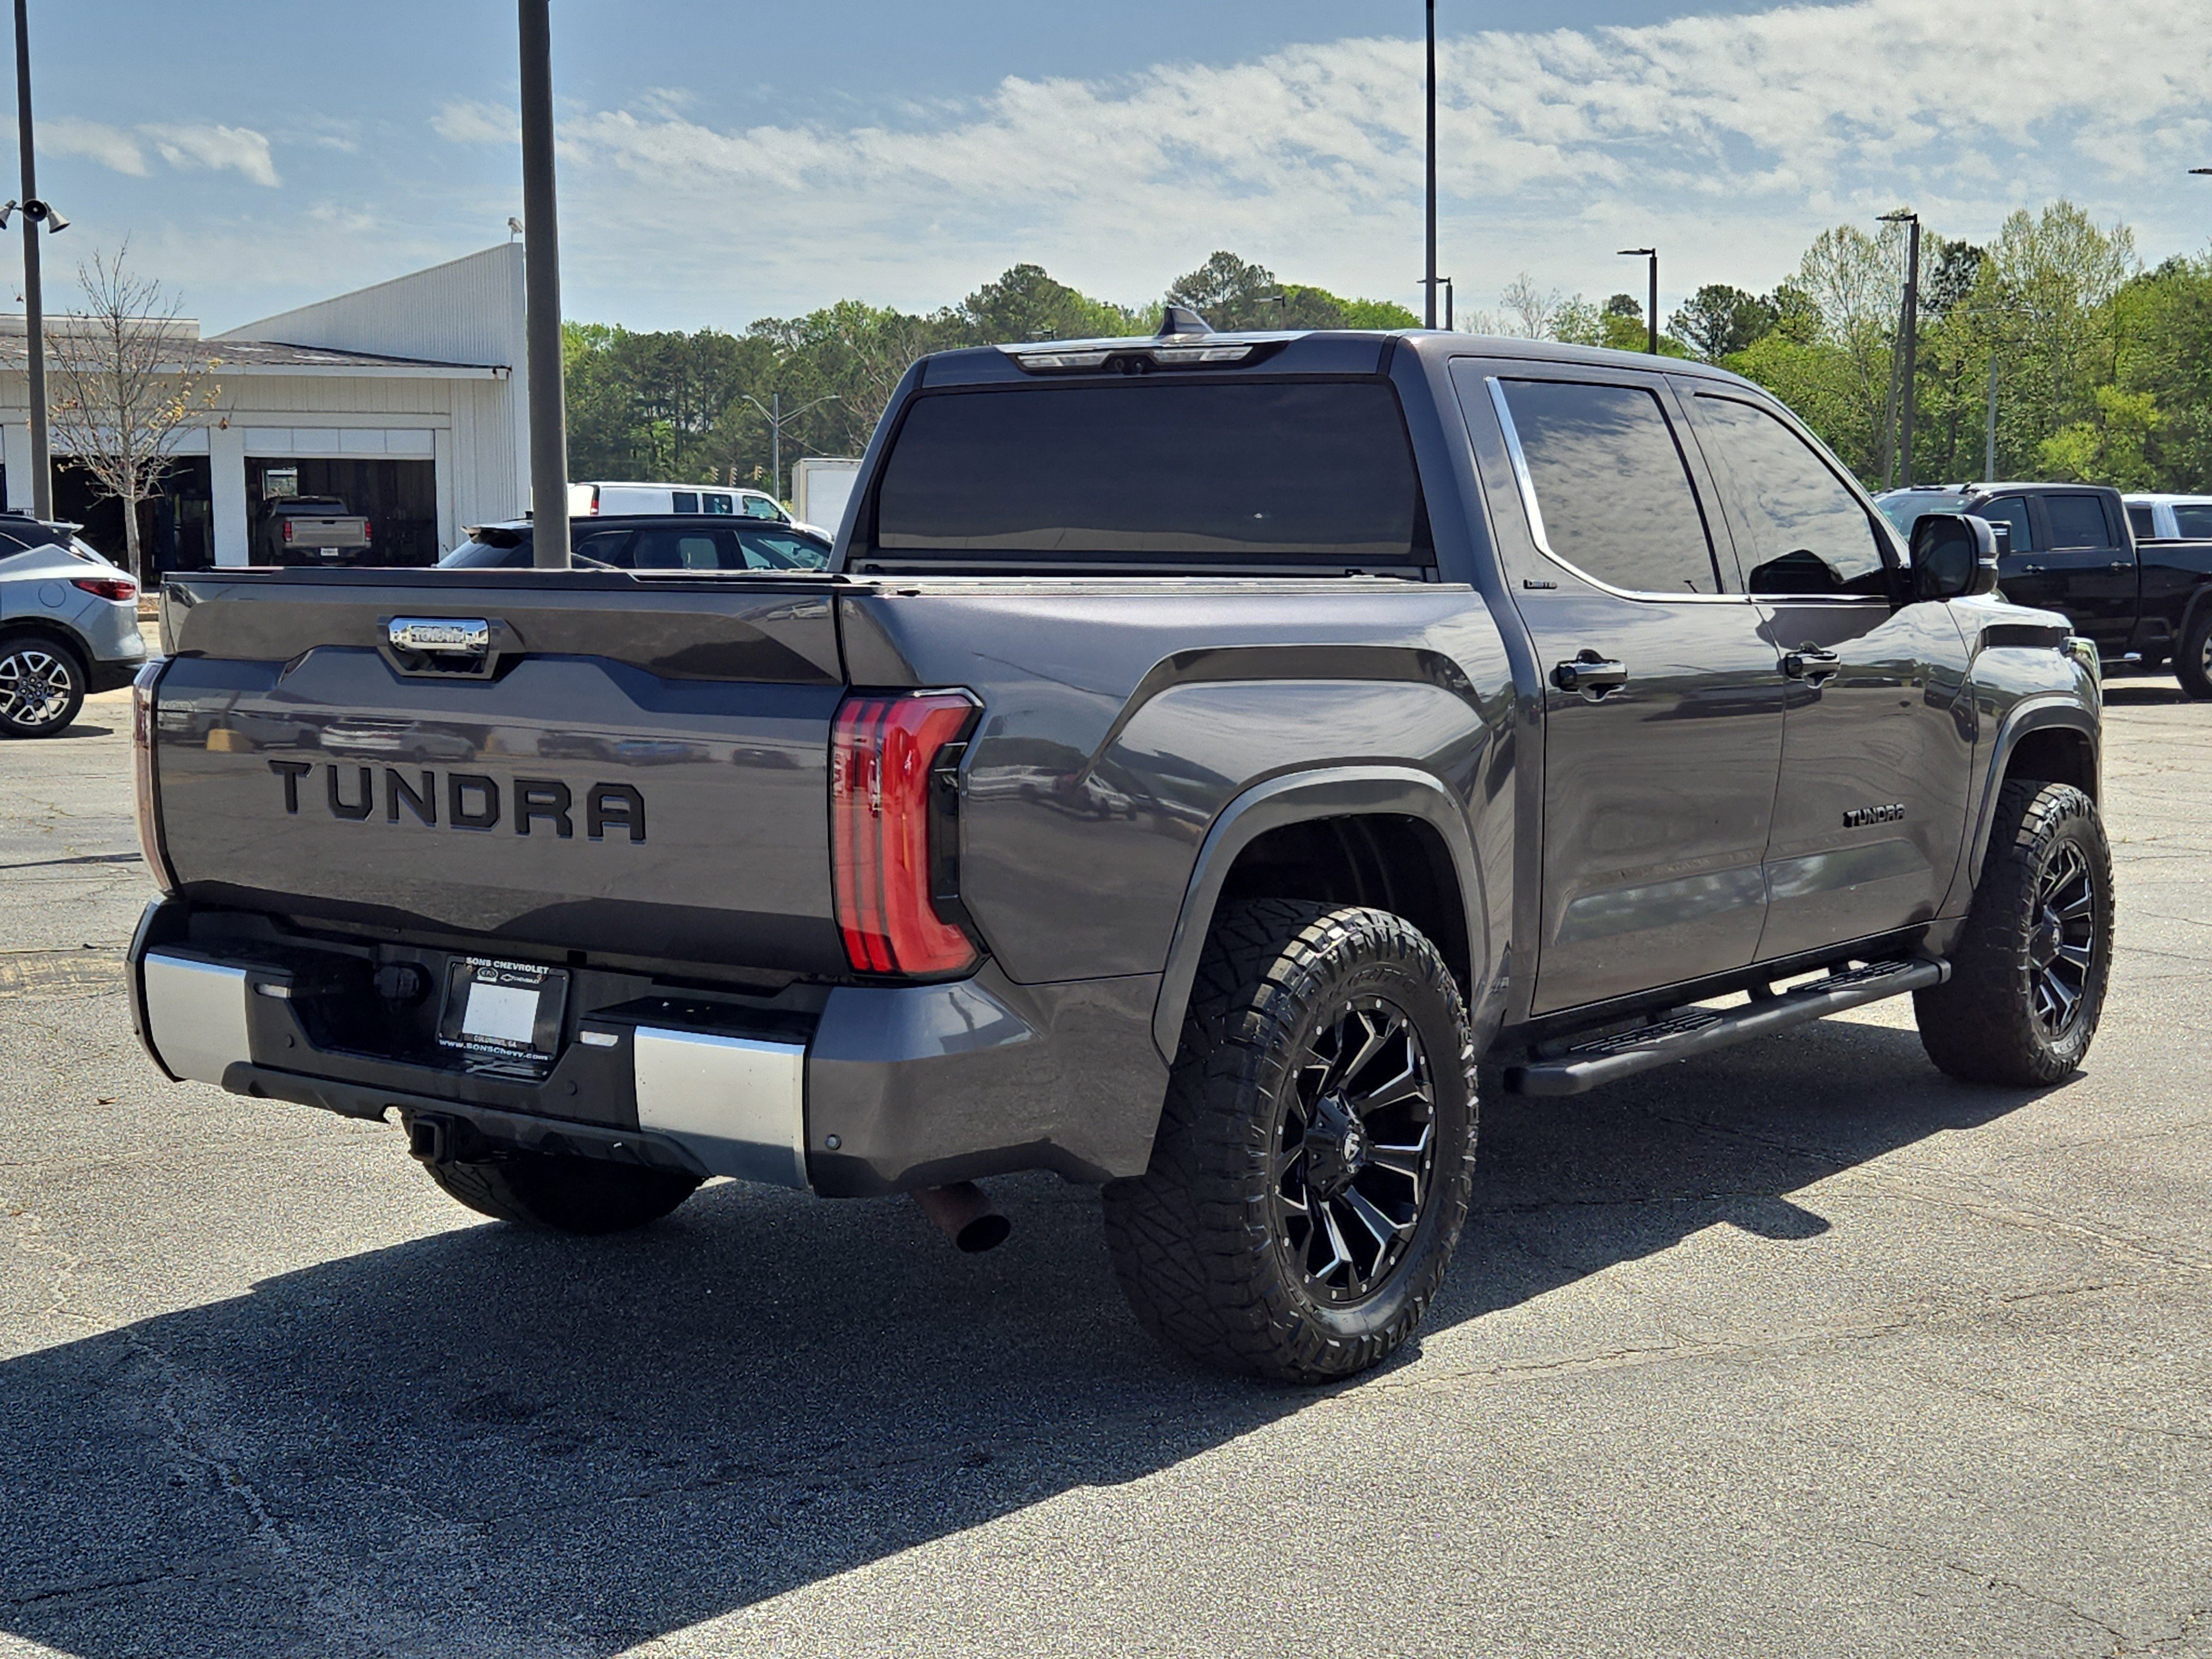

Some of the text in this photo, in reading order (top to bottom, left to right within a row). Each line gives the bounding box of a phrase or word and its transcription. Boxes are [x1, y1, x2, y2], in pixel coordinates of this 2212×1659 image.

[268, 760, 646, 844] TUNDRA
[1843, 803, 1905, 827] TUNDRA
[466, 957, 491, 967] SONS
[493, 961, 549, 974] CHEVROLET
